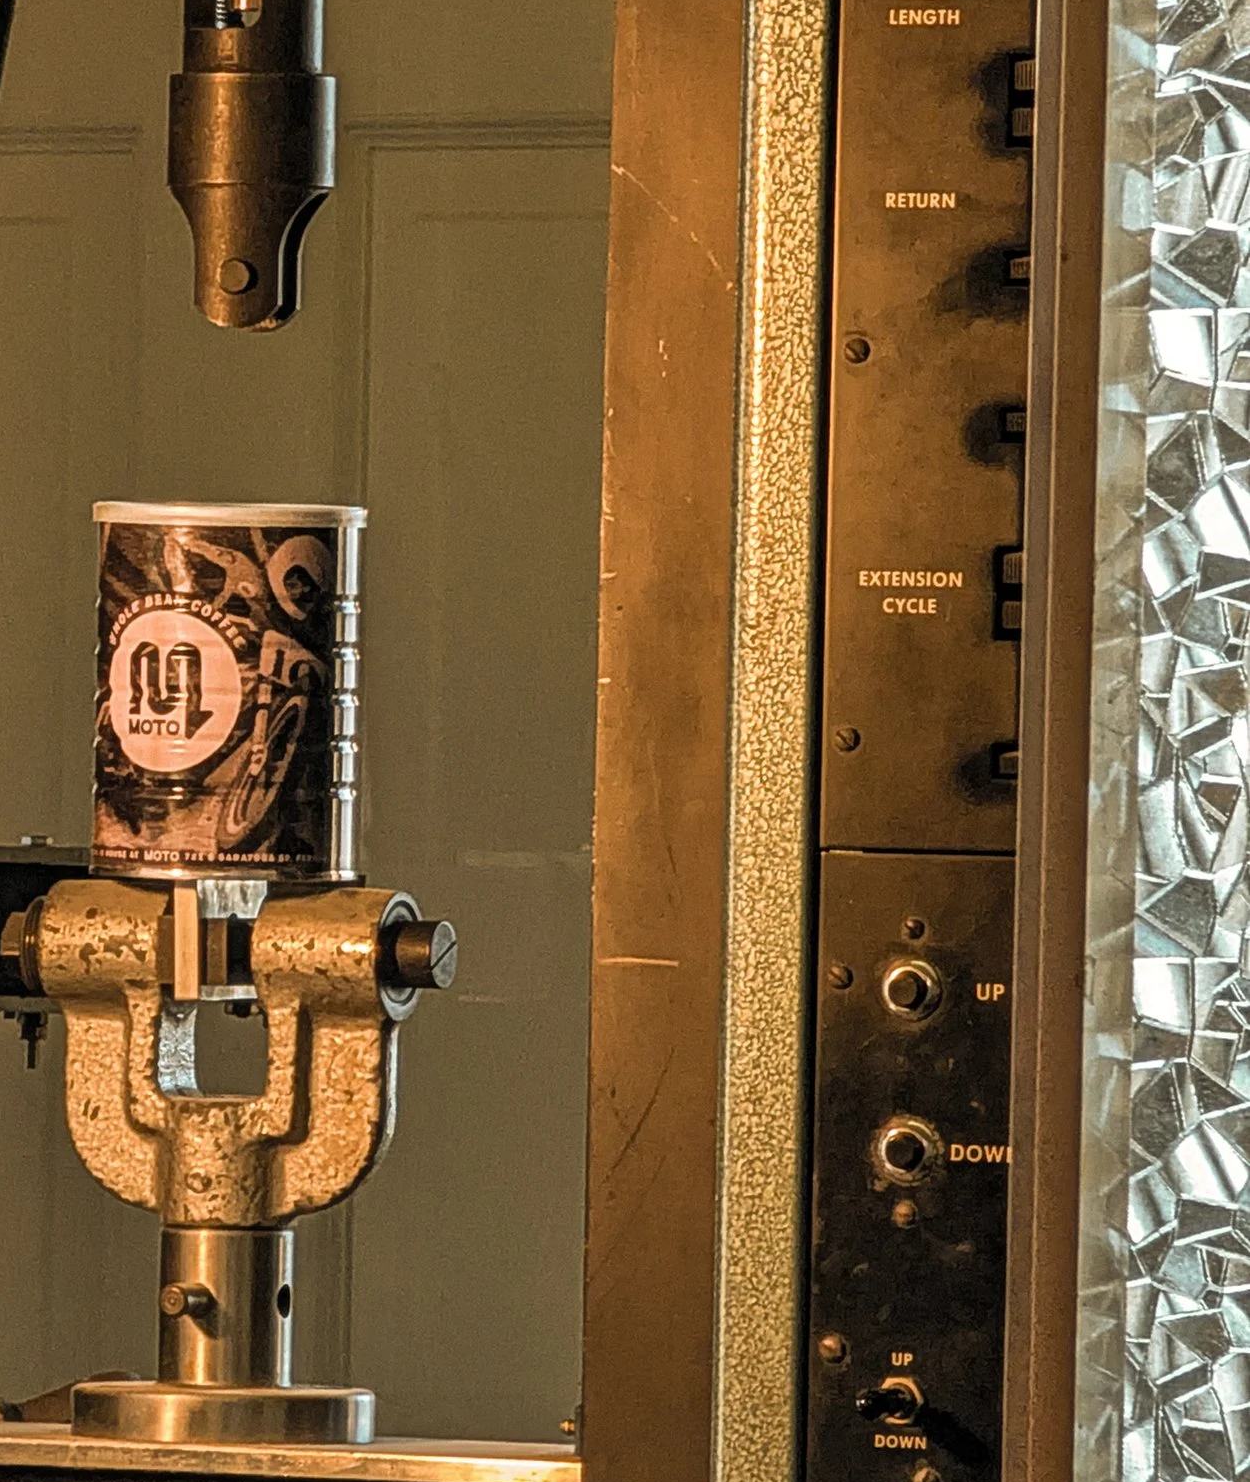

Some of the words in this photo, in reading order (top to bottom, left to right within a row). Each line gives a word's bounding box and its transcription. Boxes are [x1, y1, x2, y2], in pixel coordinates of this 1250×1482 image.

[889, 9, 961, 26] LENGTH
[885, 192, 956, 209] RETURN
[858, 571, 963, 589] EXTENSION
[882, 598, 937, 614] CYCLE
[109, 600, 140, 646] WHOLE
[191, 600, 247, 649] COFFEE
[128, 719, 180, 735] MOTO
[144, 850, 180, 862] MOTO
[976, 983, 1006, 1001] UP
[891, 1352, 913, 1367] UP
[874, 1434, 927, 1450] DOWN
